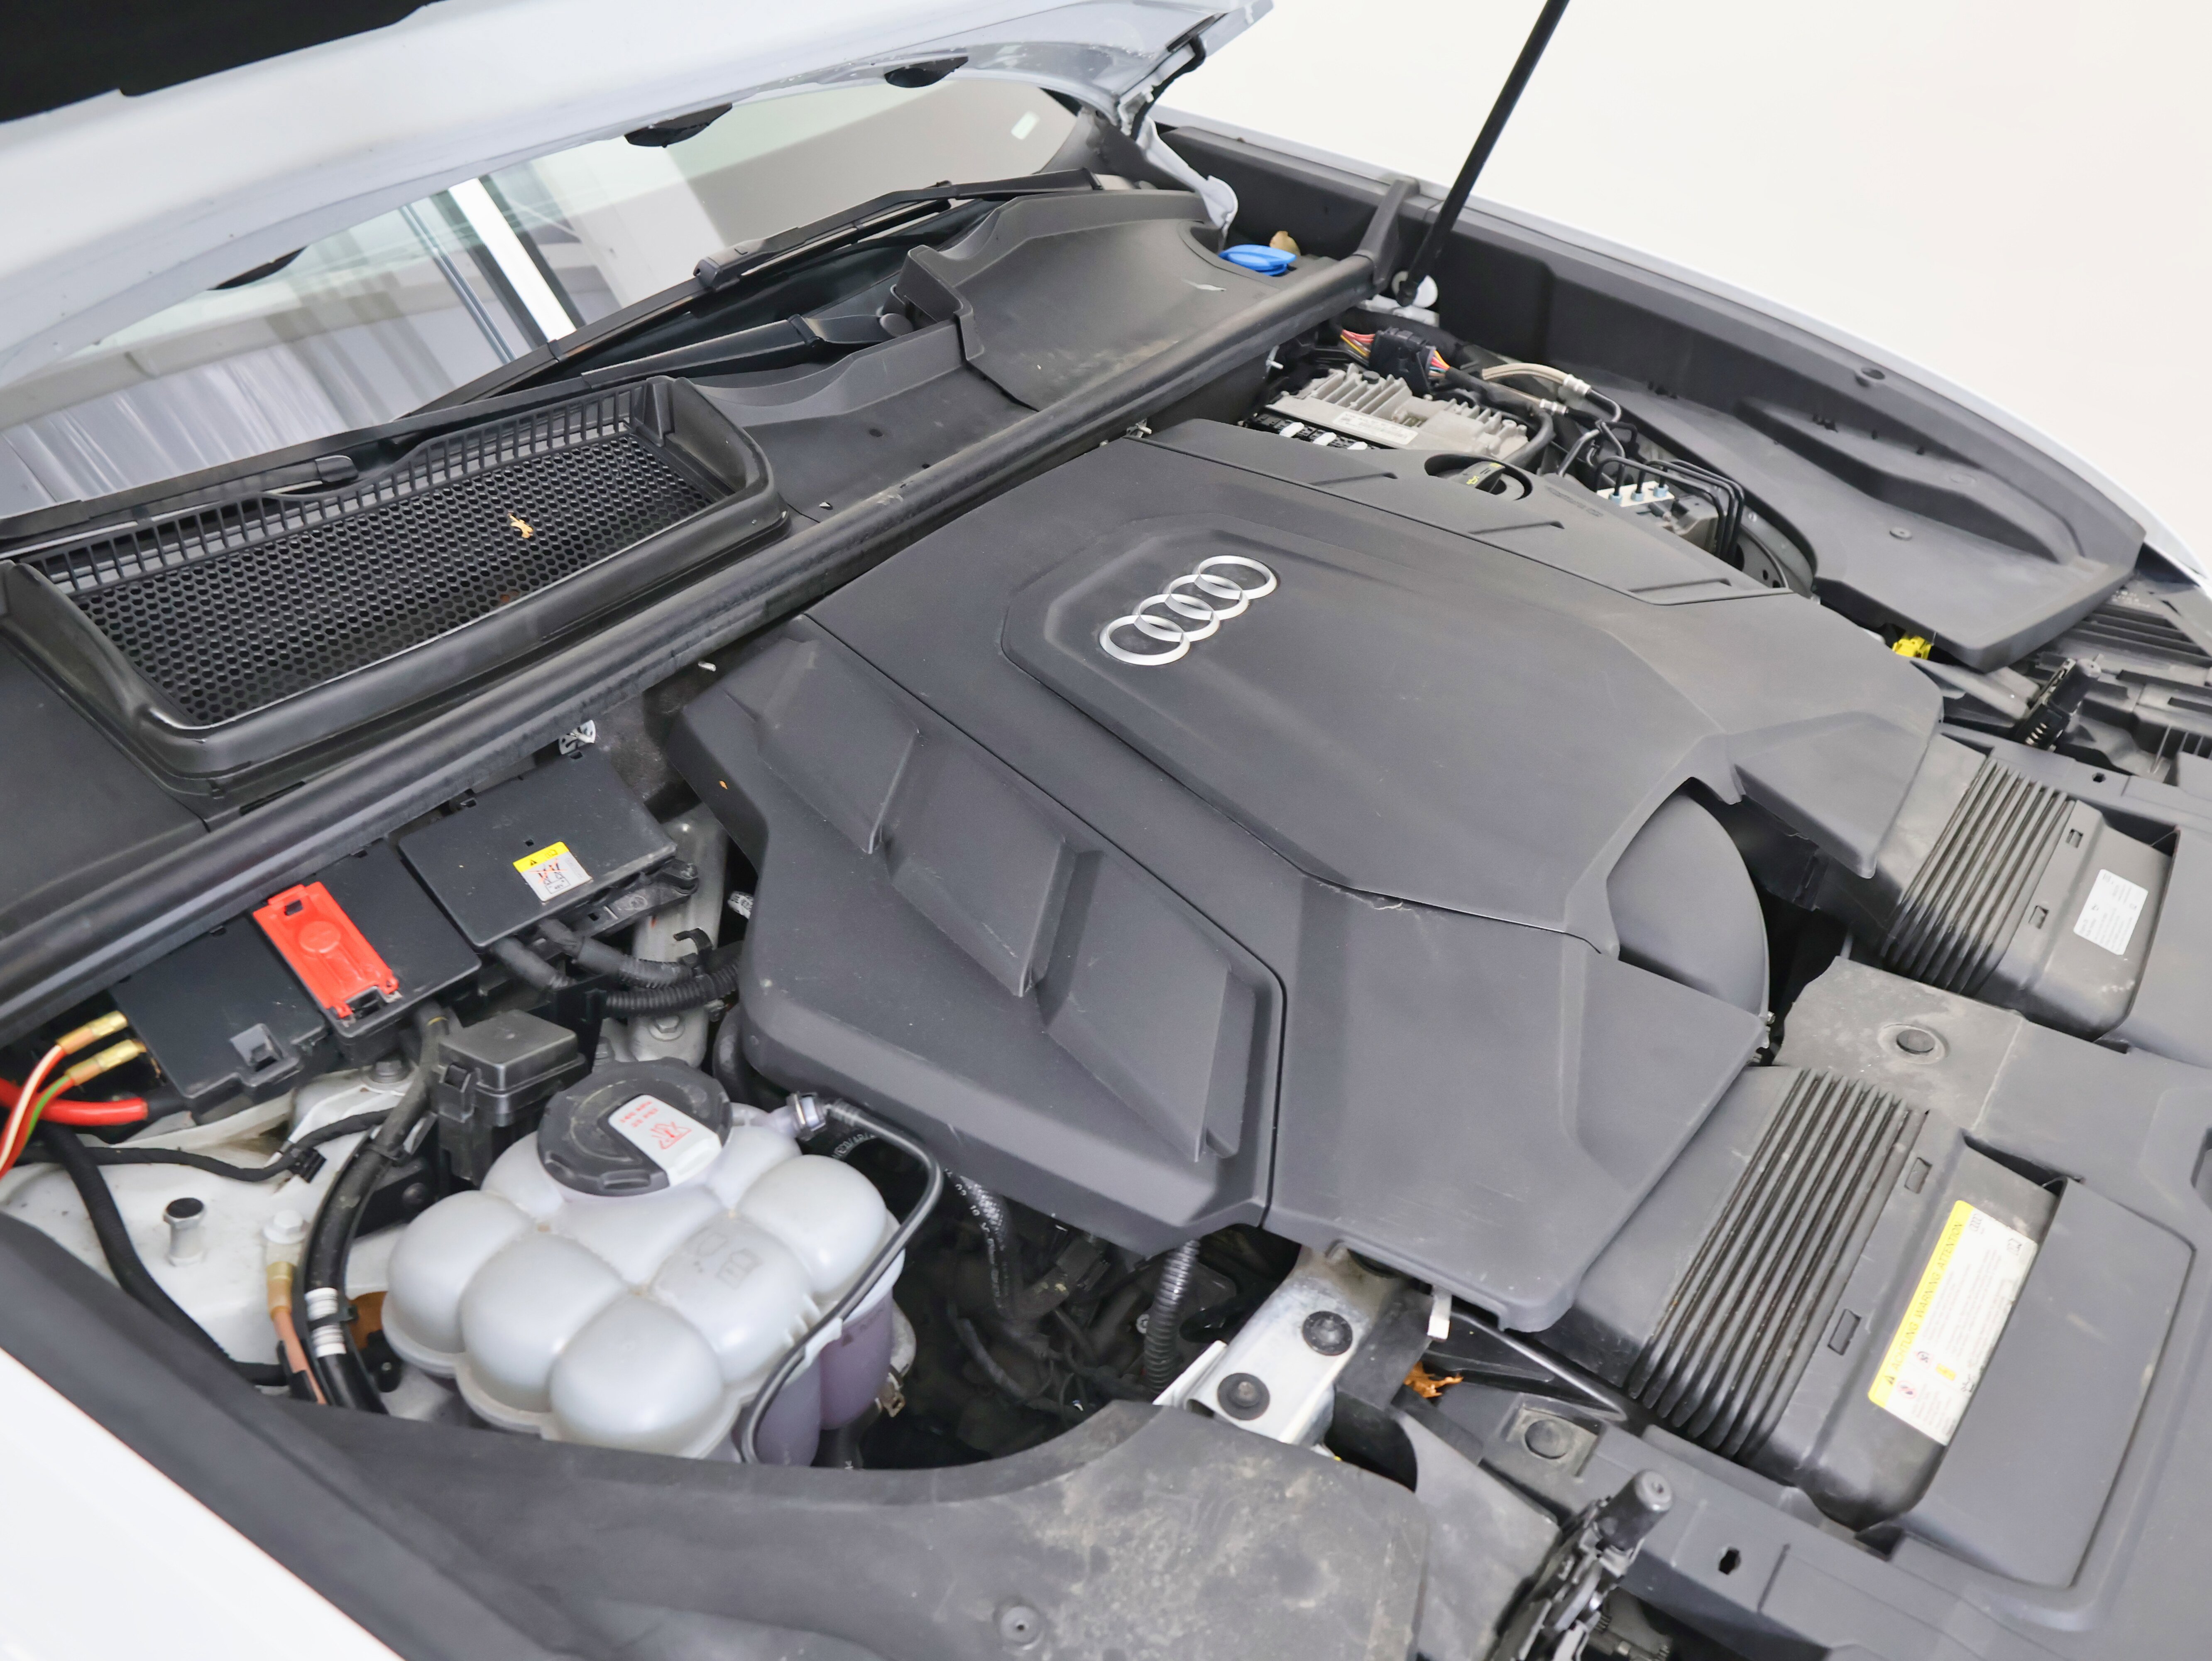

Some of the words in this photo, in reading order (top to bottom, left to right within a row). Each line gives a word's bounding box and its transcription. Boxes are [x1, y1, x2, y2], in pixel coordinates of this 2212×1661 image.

[1891, 1321, 1919, 1371] ACHTUNG
[1914, 1271, 1942, 1318] WARNING
[1936, 1221, 1963, 1270] ATTENTION
